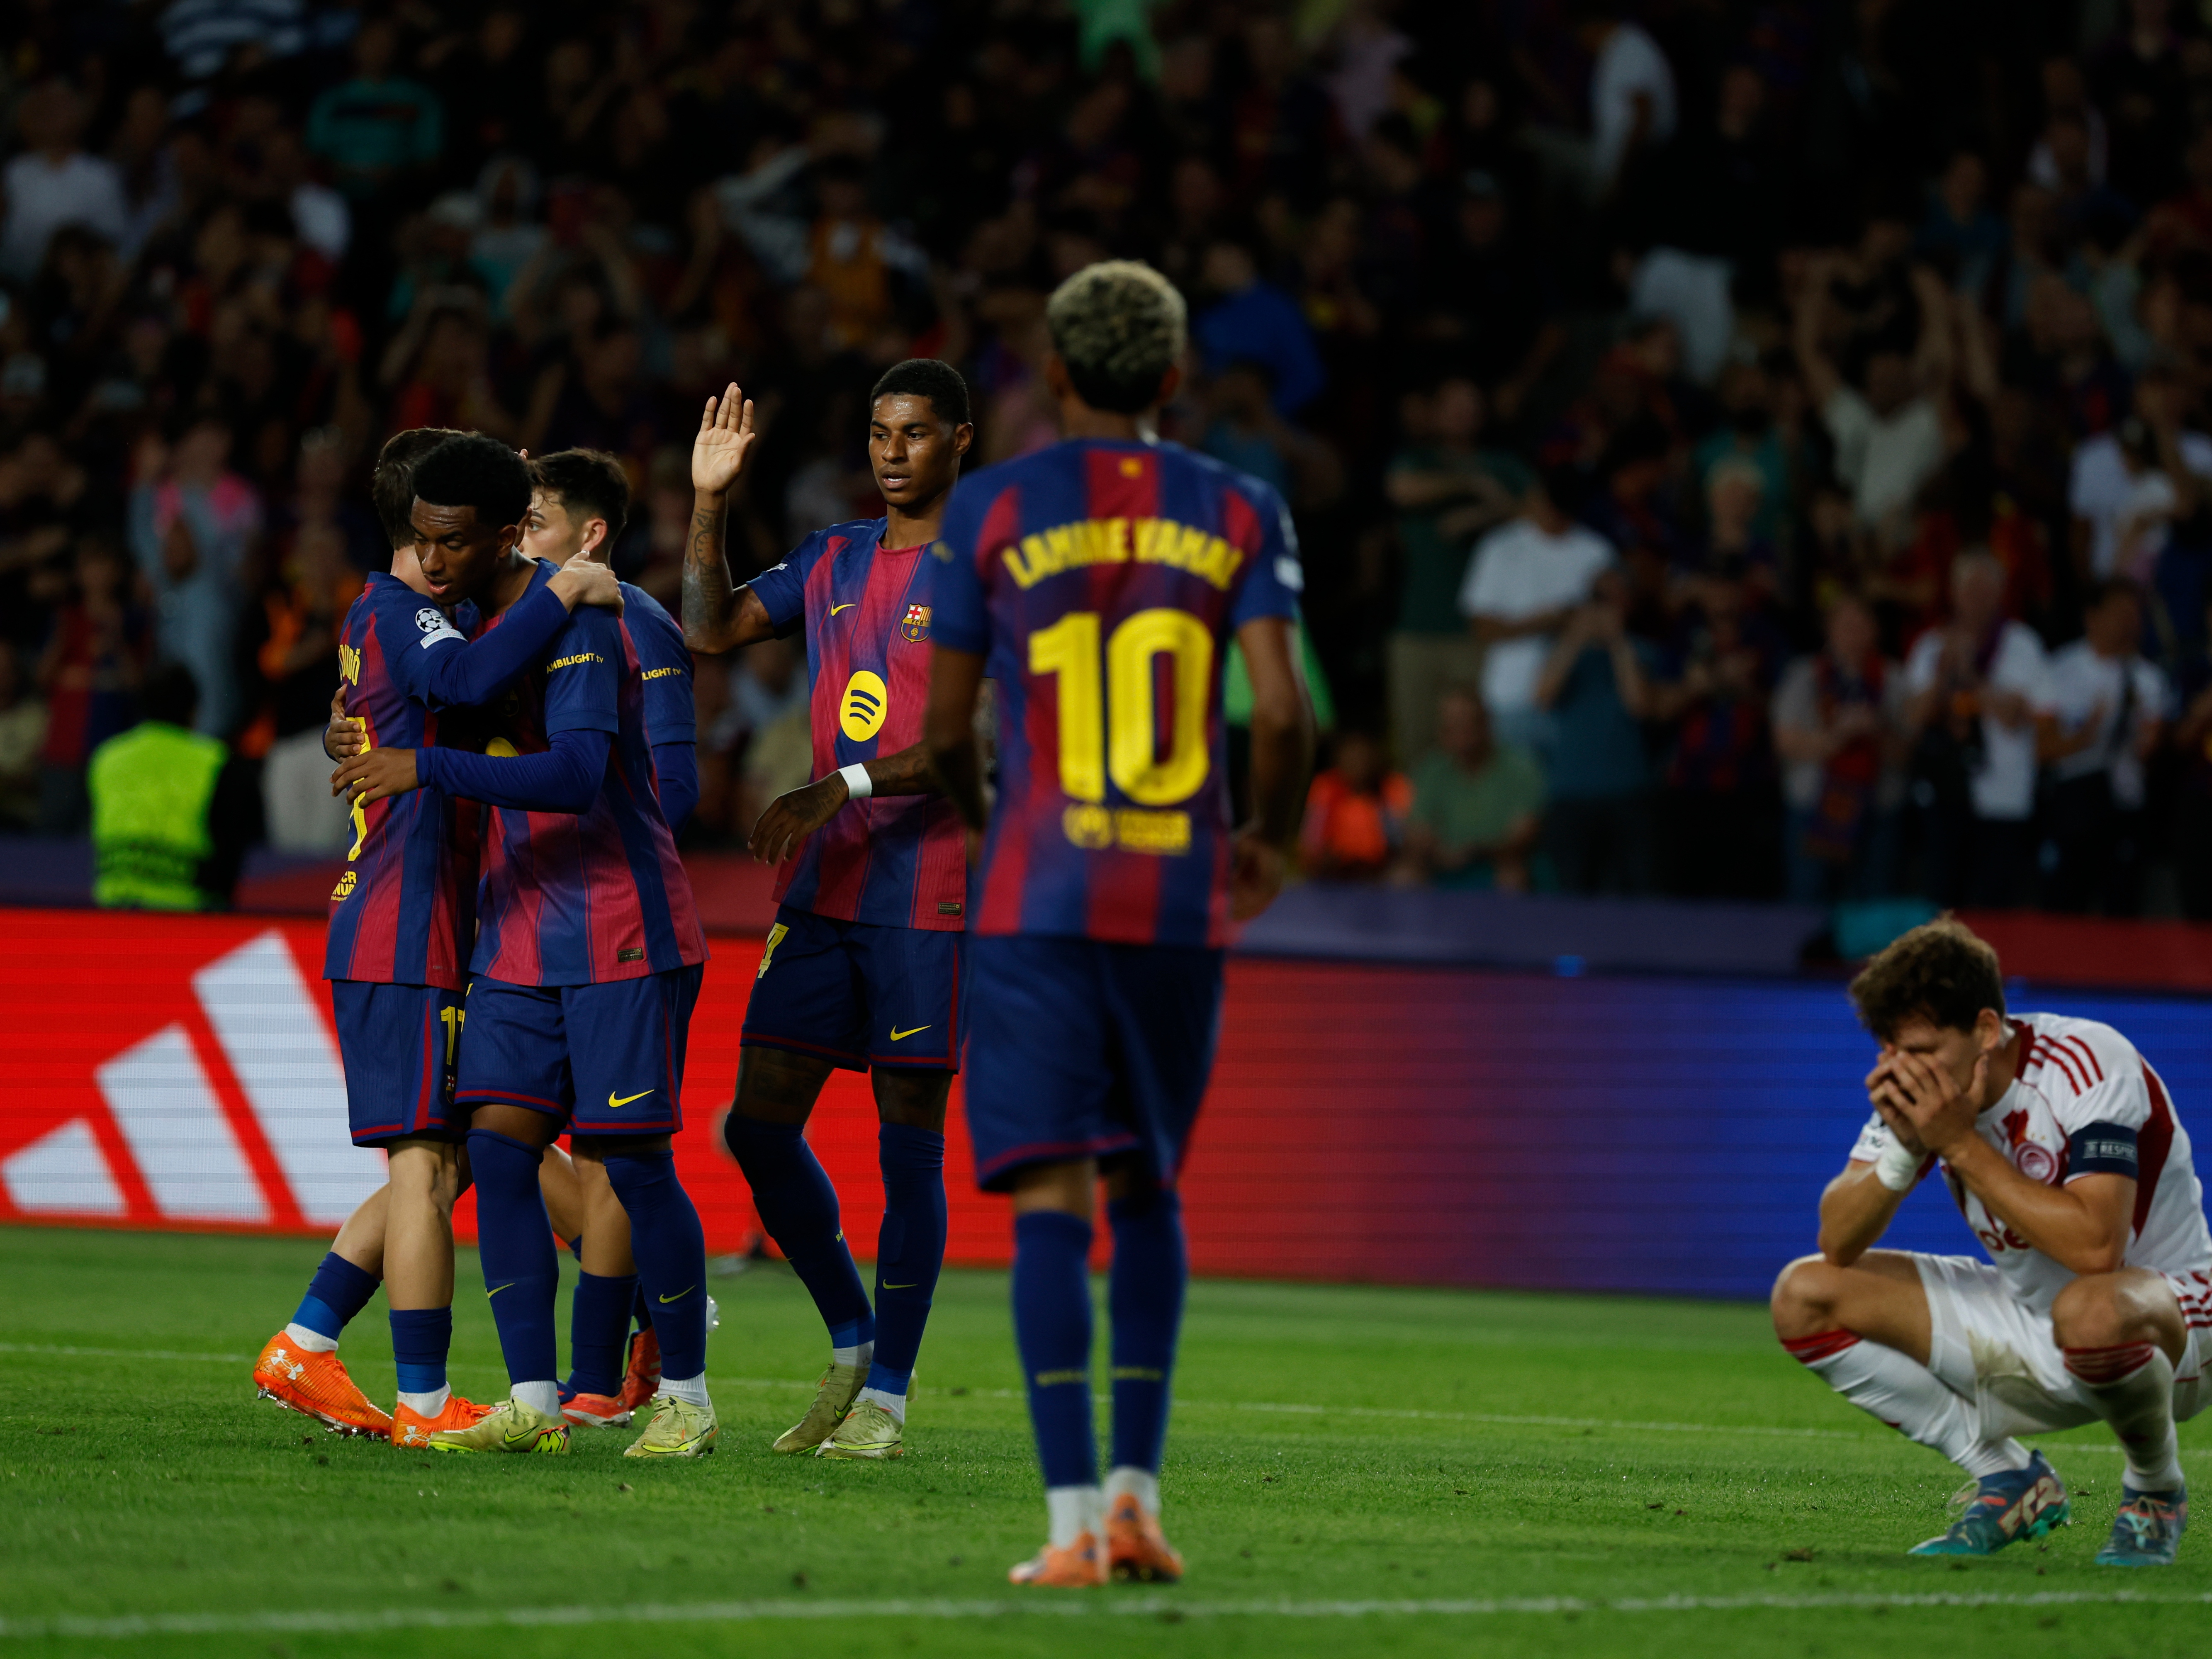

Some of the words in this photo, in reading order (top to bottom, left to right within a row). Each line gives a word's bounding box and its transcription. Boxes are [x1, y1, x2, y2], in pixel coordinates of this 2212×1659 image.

[1001, 517, 1129, 590] LAMINE
[1133, 517, 1243, 591] YAMAL
[546, 652, 595, 674] AMBILIGHT
[641, 667, 671, 681] LIGHT
[1029, 608, 1214, 806] 10
